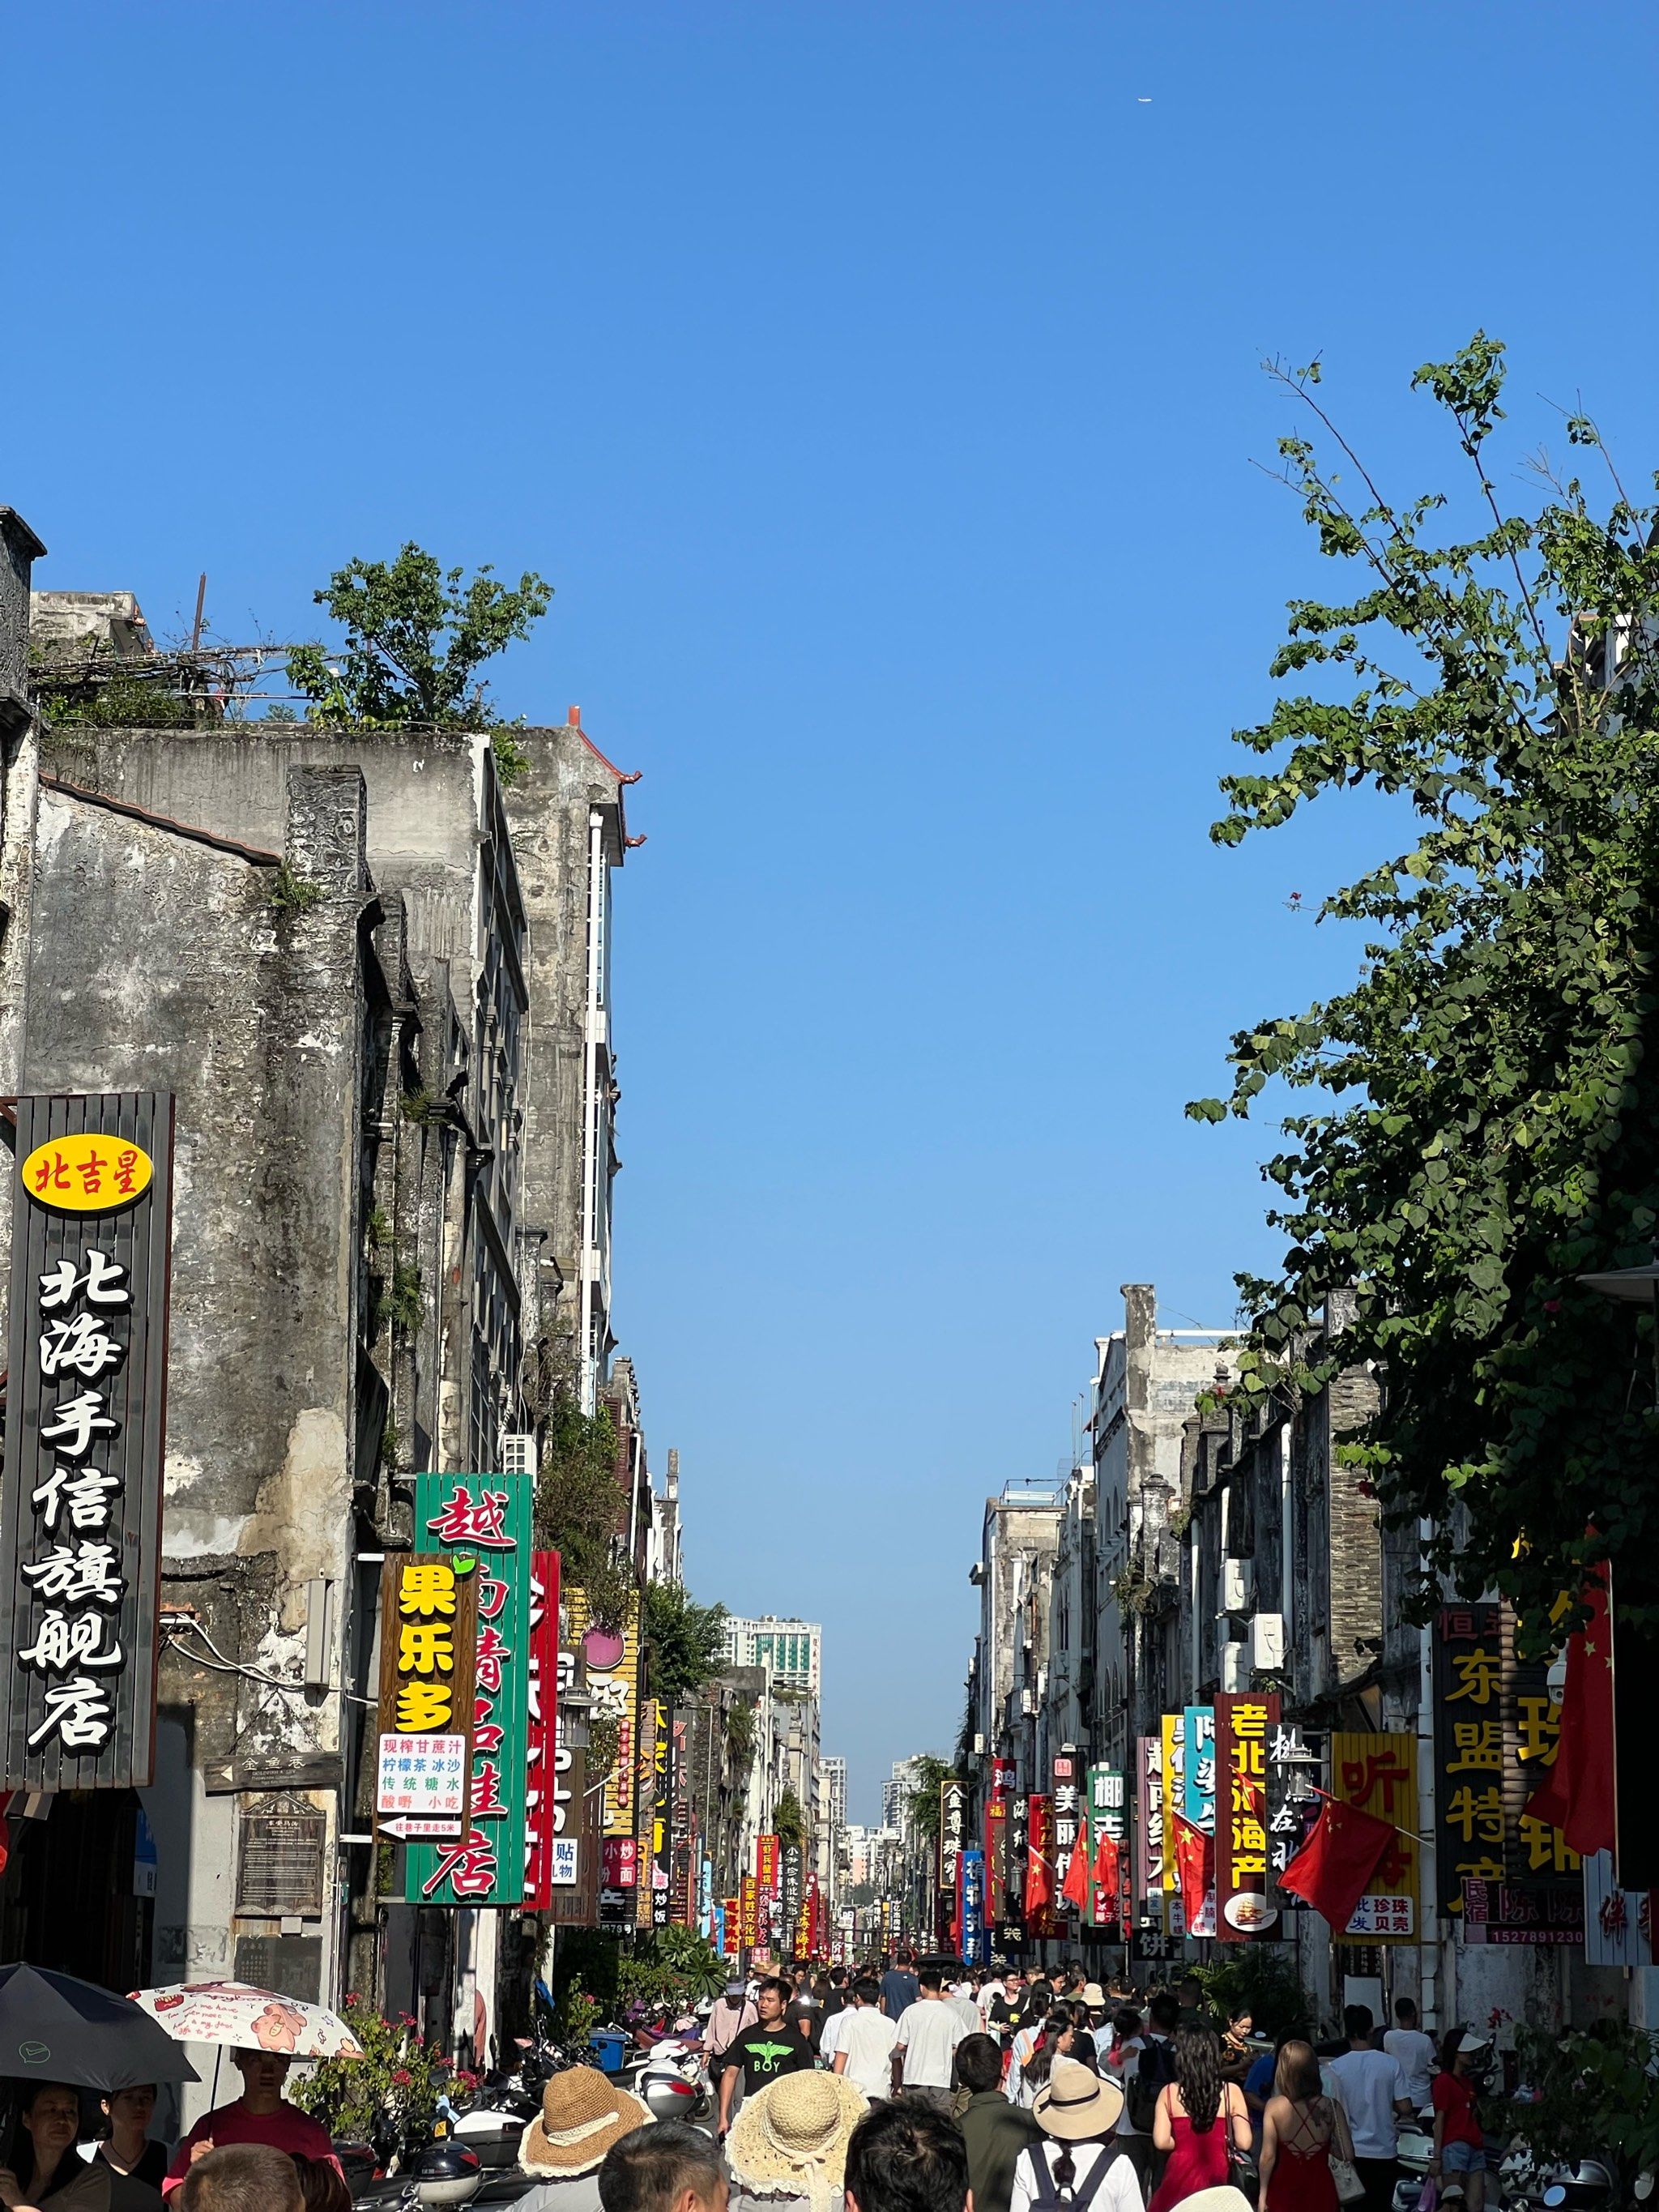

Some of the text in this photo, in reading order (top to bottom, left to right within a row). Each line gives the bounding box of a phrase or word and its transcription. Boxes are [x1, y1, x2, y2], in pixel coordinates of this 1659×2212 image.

[35, 1149, 139, 1195] 北吉星
[19, 1249, 130, 1750] 北海手信旗舰店
[394, 1565, 456, 1732] 果乐多
[383, 1739, 462, 1755] 现榨甘蔗汁
[242, 1756, 306, 1771] 金鱼巷
[382, 1757, 460, 1773] 柠檬茶 冰沙
[382, 1775, 460, 1791] 传统糖水
[1445, 1648, 1505, 1912] 东盟特产
[429, 1796, 459, 1809] 小吃
[395, 1822, 454, 1833] 往巷子里走5米
[1465, 1877, 1489, 1924] 民宿
[745, 1880, 756, 1946] 百家姓文化馆
[754, 2060, 780, 2073] BOY
